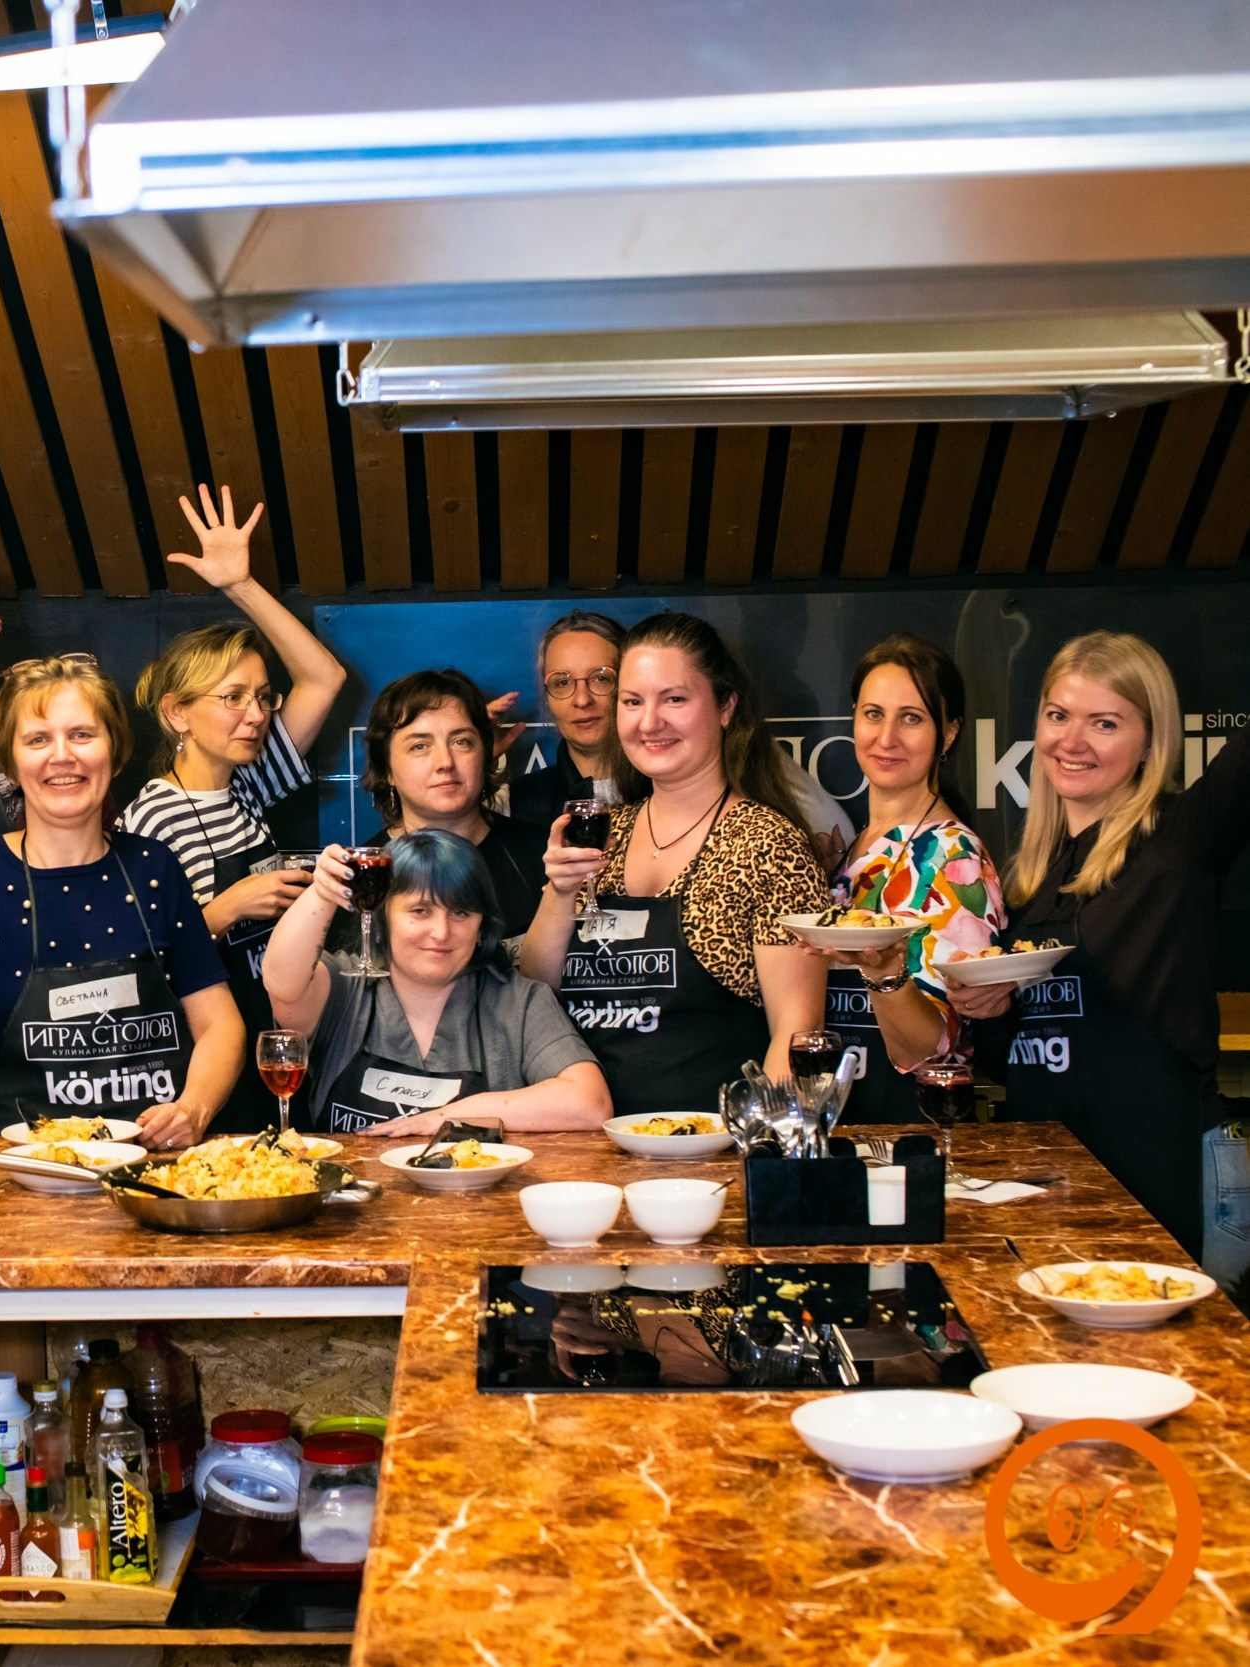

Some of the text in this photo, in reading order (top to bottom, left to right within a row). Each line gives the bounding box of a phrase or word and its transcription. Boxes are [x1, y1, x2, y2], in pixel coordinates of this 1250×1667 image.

[595, 954, 670, 977] СТОЛОВ
[1022, 981, 1076, 1005] ОЛОВ
[29, 1017, 172, 1047] ИГРА СТОЛОВ
[52, 1046, 117, 1057] КУЛИНАРНАЯ
[129, 1060, 164, 1073] since 1889
[45, 1067, 176, 1106] körting
[334, 1109, 376, 1133] ИГР
[109, 1481, 129, 1549] Altero
